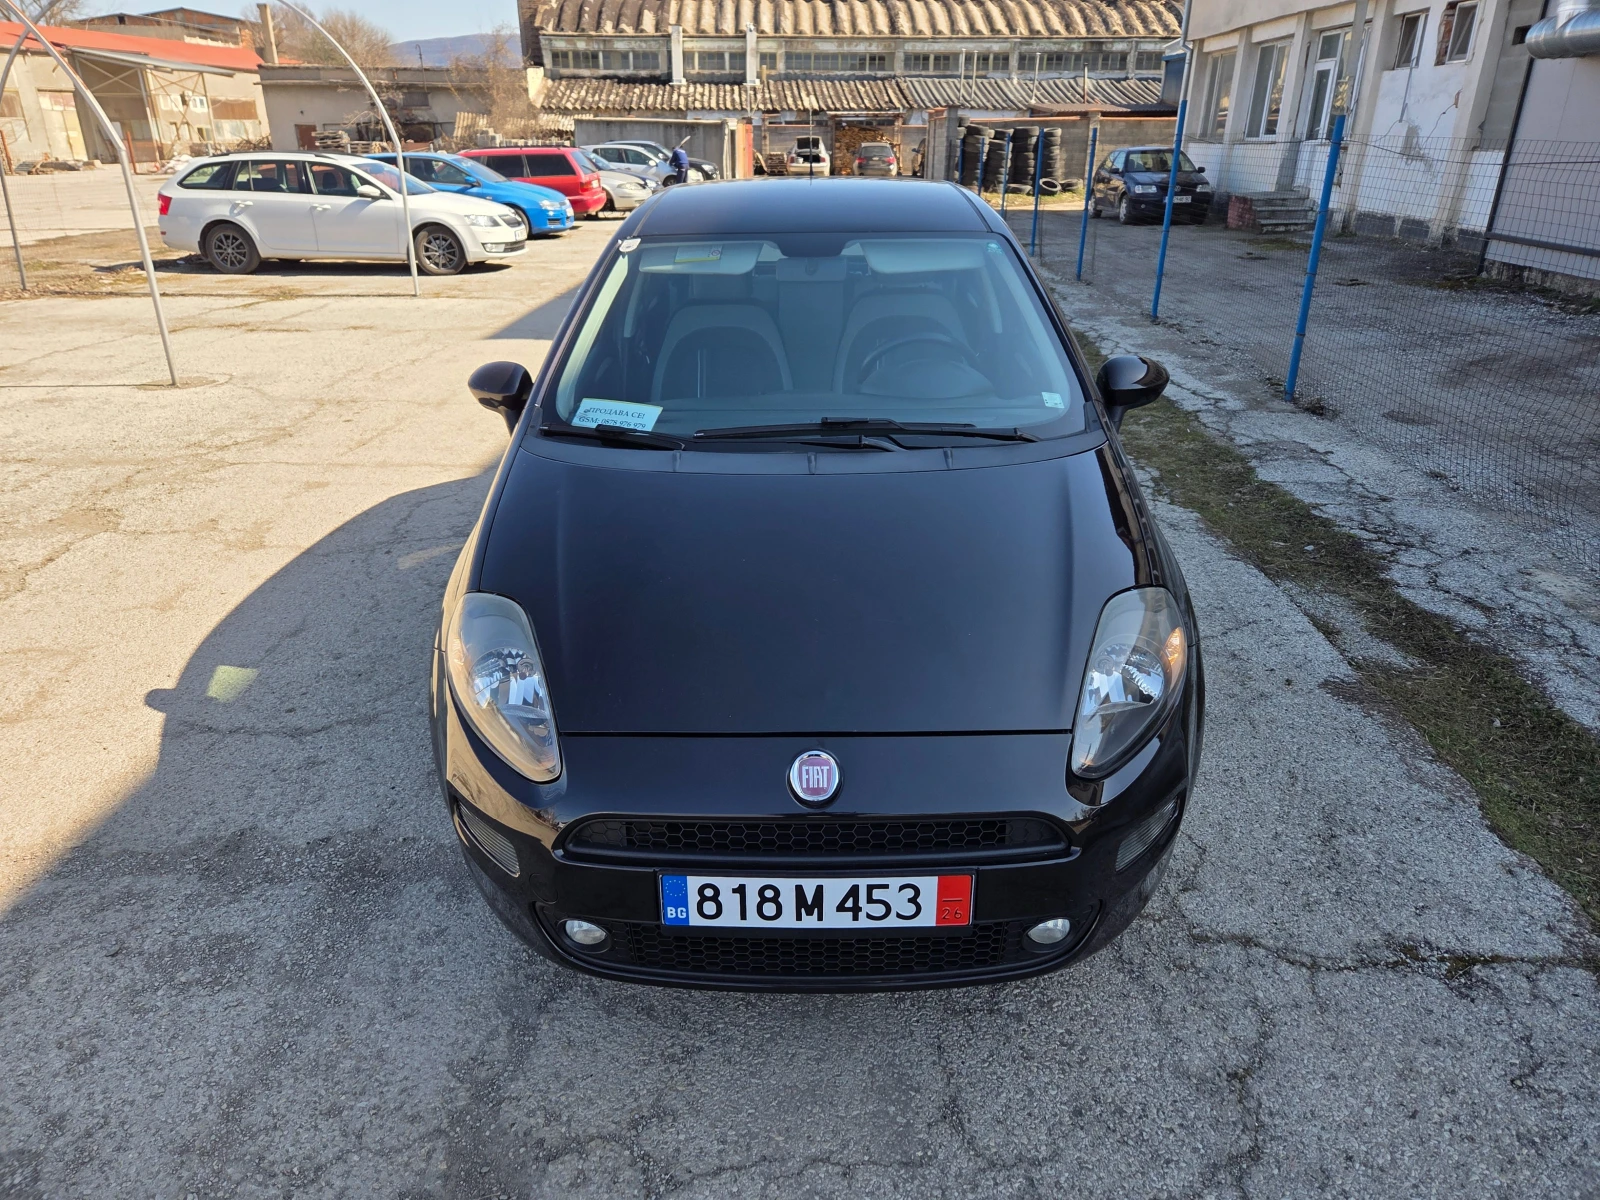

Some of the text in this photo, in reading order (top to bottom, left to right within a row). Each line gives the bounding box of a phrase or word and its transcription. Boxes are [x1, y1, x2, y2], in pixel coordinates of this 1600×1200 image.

[589, 407, 629, 417] ПРОДАВА
[578, 416, 600, 424] GSM:
[801, 765, 830, 789] FIAT
[696, 882, 922, 922] 818 M 453
[667, 906, 687, 919] BG
[942, 906, 963, 920] 26
